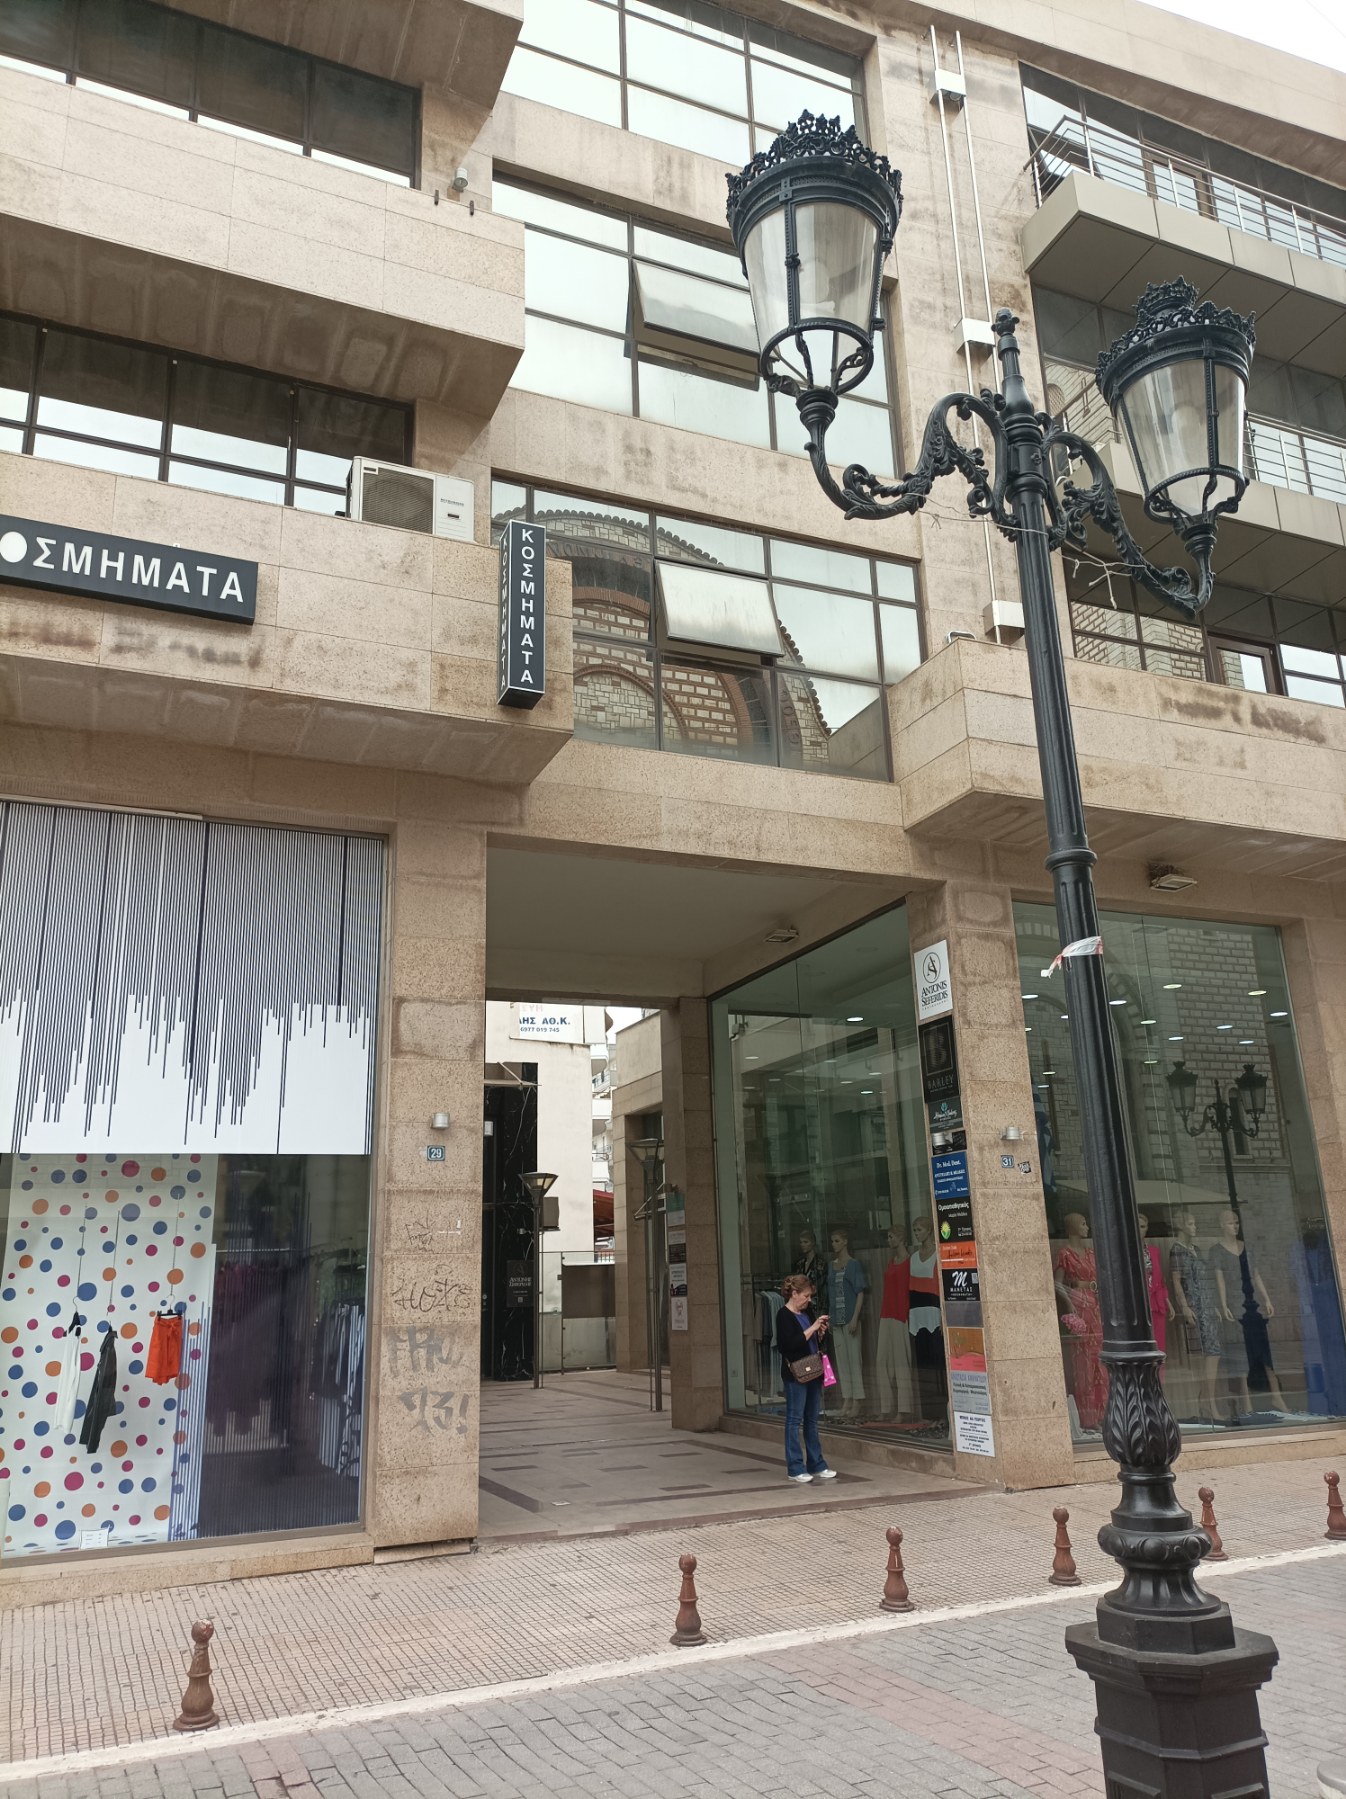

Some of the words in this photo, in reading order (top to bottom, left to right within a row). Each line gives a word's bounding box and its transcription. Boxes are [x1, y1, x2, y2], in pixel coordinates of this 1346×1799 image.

[520, 528, 535, 685] ΚΟΣΜΗΜΑΤΑ
[921, 981, 948, 998] ANTONIS
[430, 1149, 442, 1158] 29
[1002, 1157, 1013, 1166] 31
